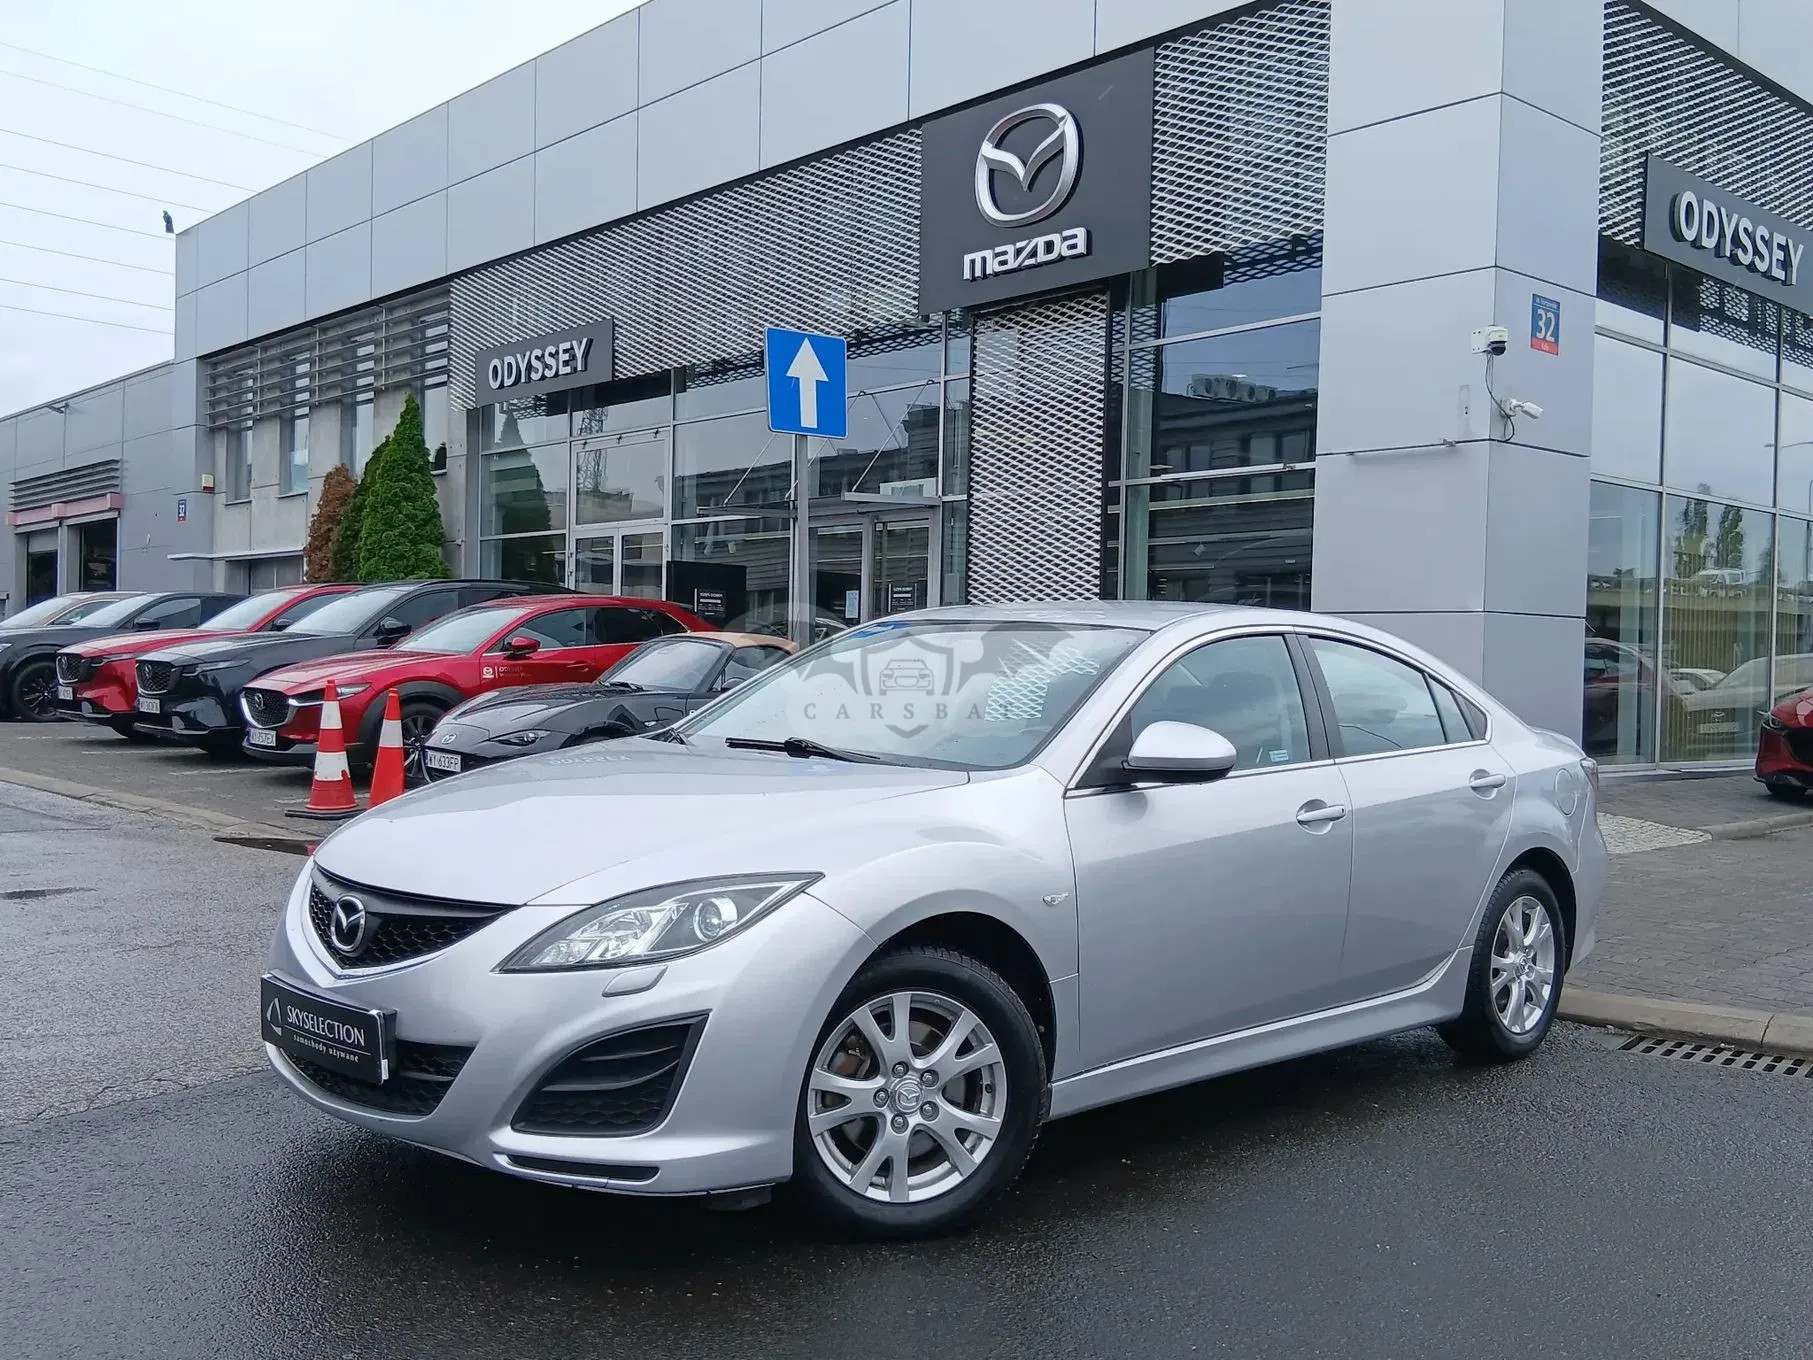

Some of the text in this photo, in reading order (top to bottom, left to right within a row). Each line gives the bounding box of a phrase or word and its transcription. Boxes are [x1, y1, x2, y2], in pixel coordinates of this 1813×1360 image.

[963, 227, 1087, 280] mazda
[1676, 190, 1804, 286] ODYSSEY
[1535, 308, 1556, 342] 32
[488, 336, 590, 389] ODYSSEY
[287, 1004, 366, 1047] SKYSELECTION
